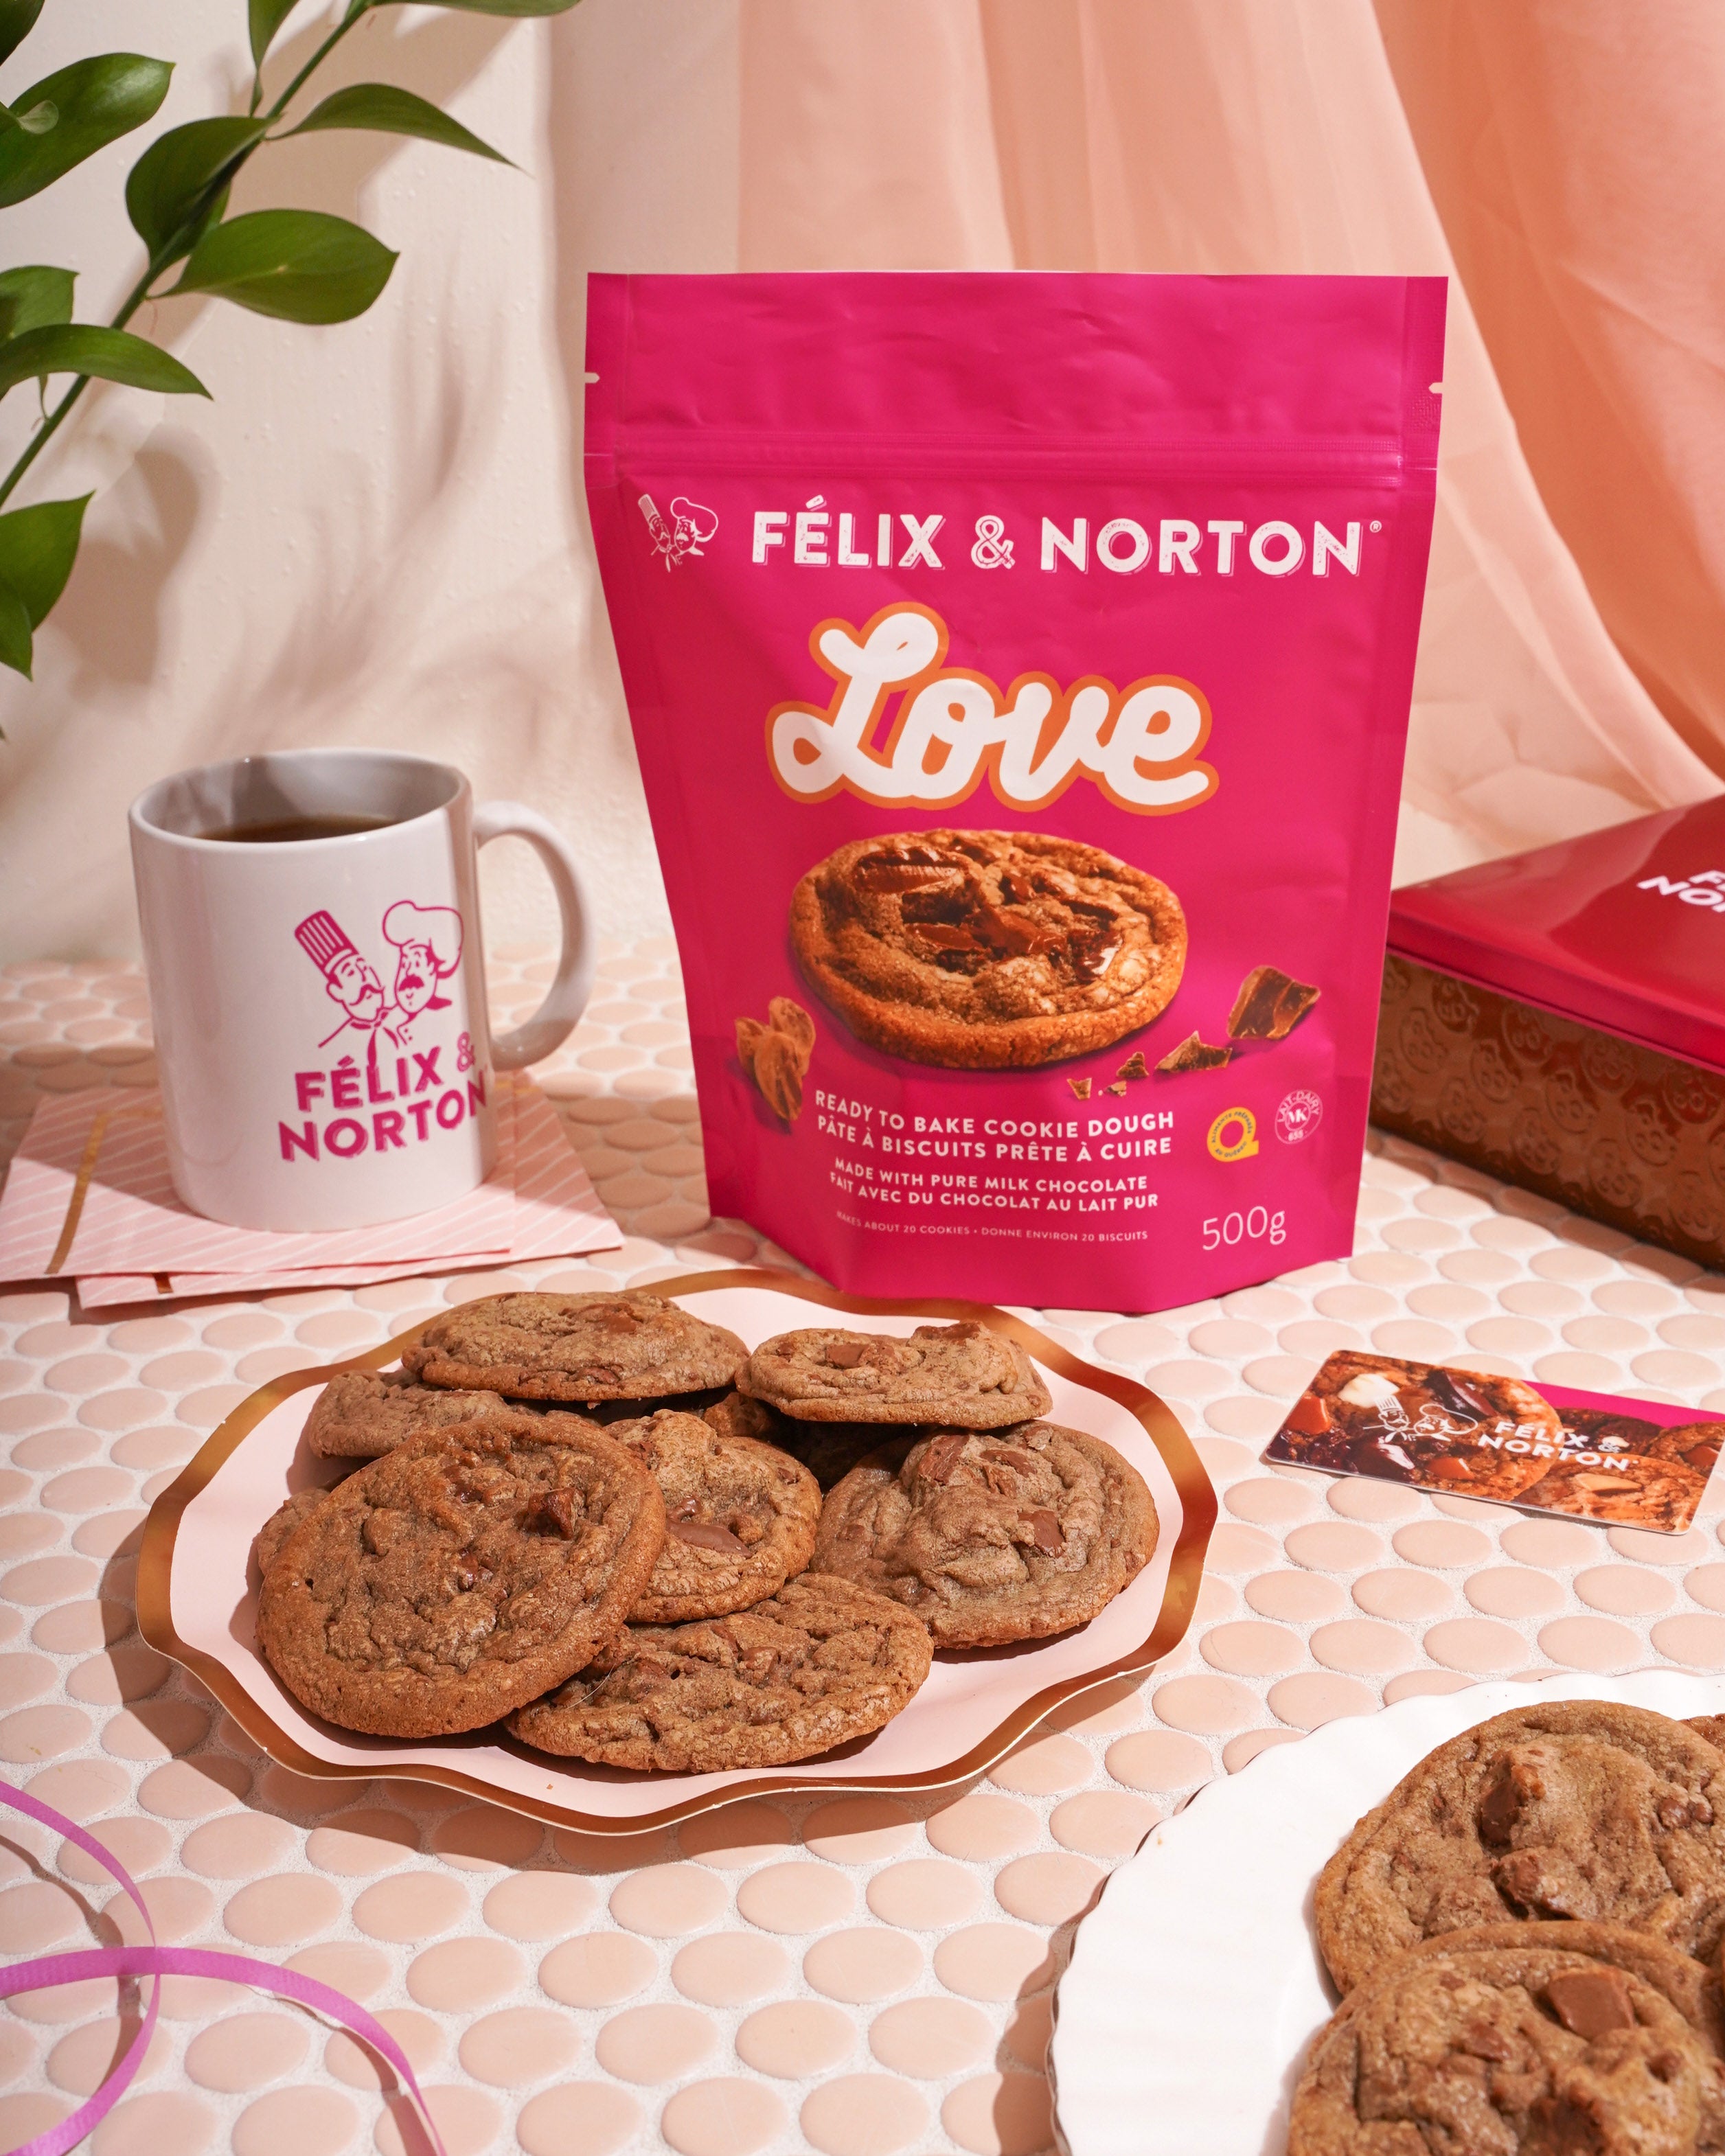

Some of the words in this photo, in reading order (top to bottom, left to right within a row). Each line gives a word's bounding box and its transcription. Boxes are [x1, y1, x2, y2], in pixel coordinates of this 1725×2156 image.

[752, 494, 946, 570] FÉLIX
[970, 514, 1016, 570] &
[770, 608, 1213, 812] Love
[295, 1046, 444, 1112] FÉLIX
[457, 1031, 475, 1072] &
[279, 1070, 486, 1161] NORTON
[815, 1089, 873, 1123] READY
[878, 1110, 905, 1131] TO
[913, 1116, 975, 1134] BAKE
[983, 1119, 1079, 1138] COOKIE
[1088, 1111, 1174, 1137] DOUGH
[817, 1114, 857, 1143] PÂTE
[861, 1127, 875, 1149] À
[882, 1136, 987, 1159] BISCUITS
[996, 1140, 1068, 1162] PRÊTE
[1075, 1142, 1093, 1162] À
[1100, 1136, 1172, 1160] CUIRE
[830, 1171, 854, 1194] FAIT
[857, 1186, 902, 1204] AVEC
[908, 1191, 933, 1205] DU
[939, 1192, 1040, 1211] CHOCOLAT
[1046, 1198, 1072, 1211] AU
[1078, 1198, 1117, 1212] LAIT
[1124, 1194, 1158, 1210] PUR
[835, 1157, 874, 1180] MADE
[879, 1169, 924, 1187] WITH
[930, 1173, 978, 1189] PURE
[985, 1176, 1030, 1191] MILK
[1035, 1176, 1148, 1193] CHOCOLATE
[836, 1210, 862, 1228] MAKES
[865, 1220, 900, 1232] ABOUT
[904, 1224, 917, 1234] 20
[919, 1225, 970, 1235] COOKIES
[981, 1227, 1023, 1237] DONNE
[1026, 1230, 1078, 1241] ENVIRON
[1082, 1232, 1095, 1242] 20
[1098, 1230, 1148, 1242] BISCUITS
[1202, 1205, 1287, 1251] 500g
[1495, 1421, 1590, 1449] FÉLIX
[1597, 1441, 1622, 1454] &
